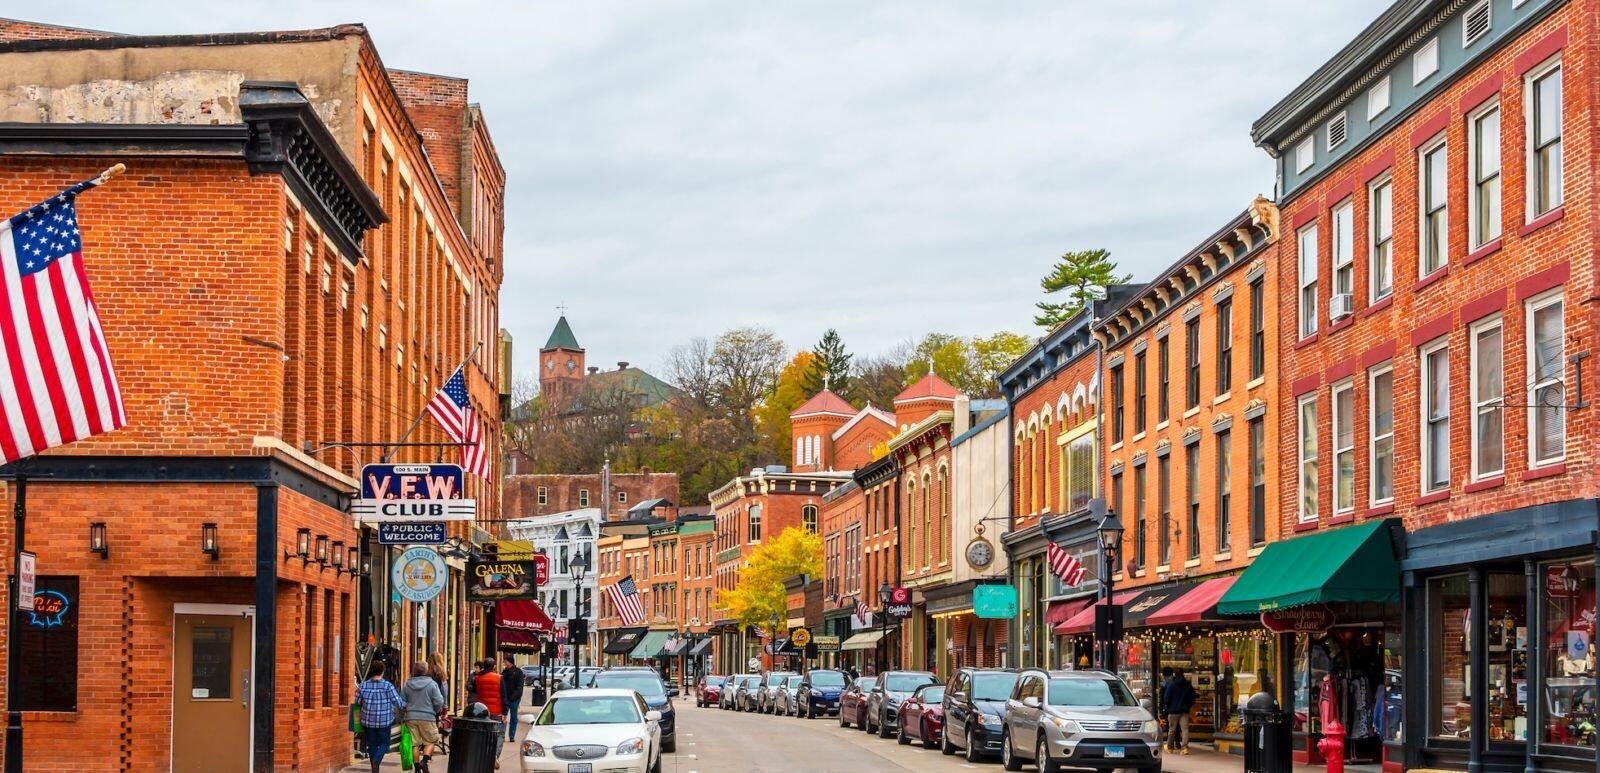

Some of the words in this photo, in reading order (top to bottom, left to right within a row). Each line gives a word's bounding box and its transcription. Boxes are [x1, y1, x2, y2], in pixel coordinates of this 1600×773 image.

[381, 503, 444, 517] CLUB
[392, 524, 434, 533] PUBLIC
[384, 532, 442, 542] WELCOME
[404, 548, 437, 561] EARTH'S
[475, 563, 526, 578] GALENA
[399, 585, 441, 600] TREASURES
